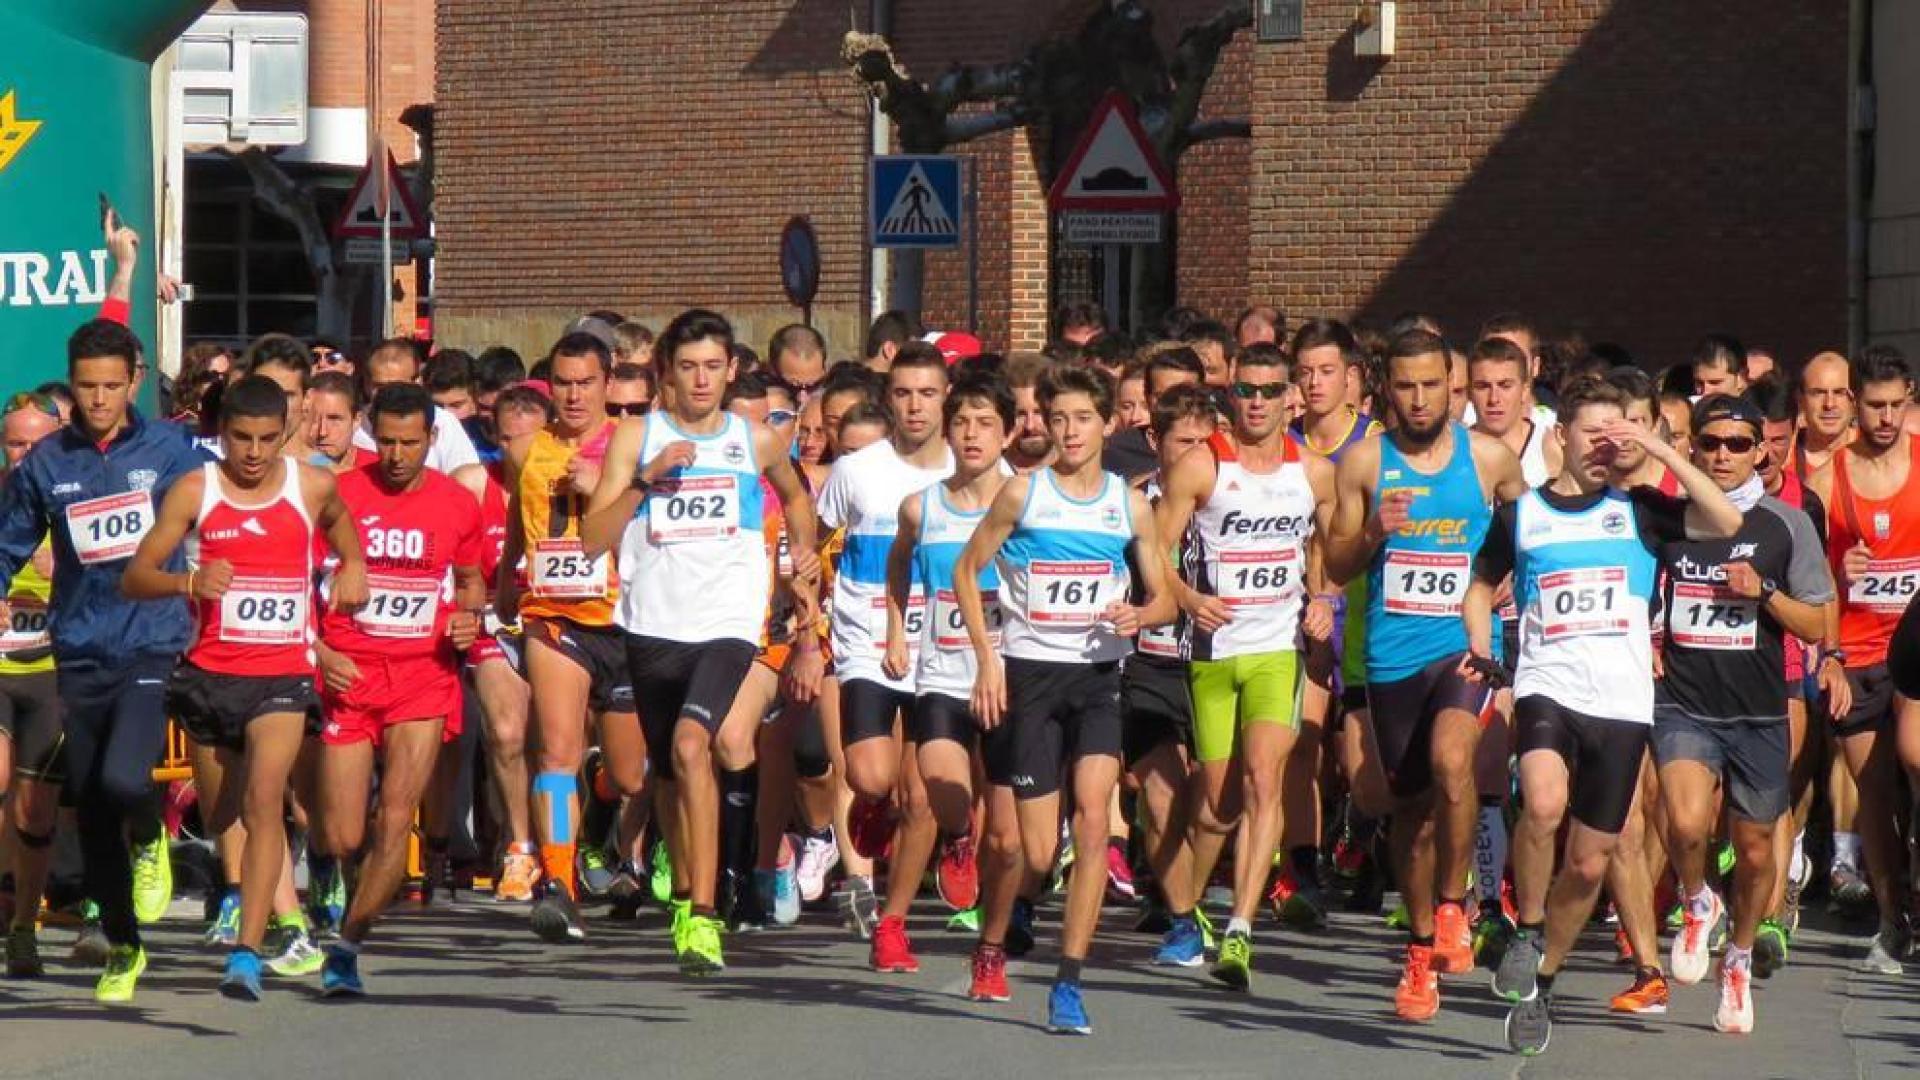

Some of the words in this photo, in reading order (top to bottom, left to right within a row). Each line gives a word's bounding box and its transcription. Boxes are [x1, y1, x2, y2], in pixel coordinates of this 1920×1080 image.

[0, 249, 108, 305] RAL
[667, 495, 726, 520] 062
[88, 511, 142, 541] 108
[1398, 518, 1469, 537] errer
[366, 527, 425, 559] 360
[545, 556, 595, 578] 253
[1235, 566, 1289, 590] 168
[1046, 580, 1100, 604] 161
[1401, 569, 1458, 596] 136
[1863, 573, 1915, 596] 245
[237, 597, 296, 622] 083
[373, 594, 429, 619] 197
[1555, 586, 1615, 615] 051
[1688, 602, 1745, 629] 175
